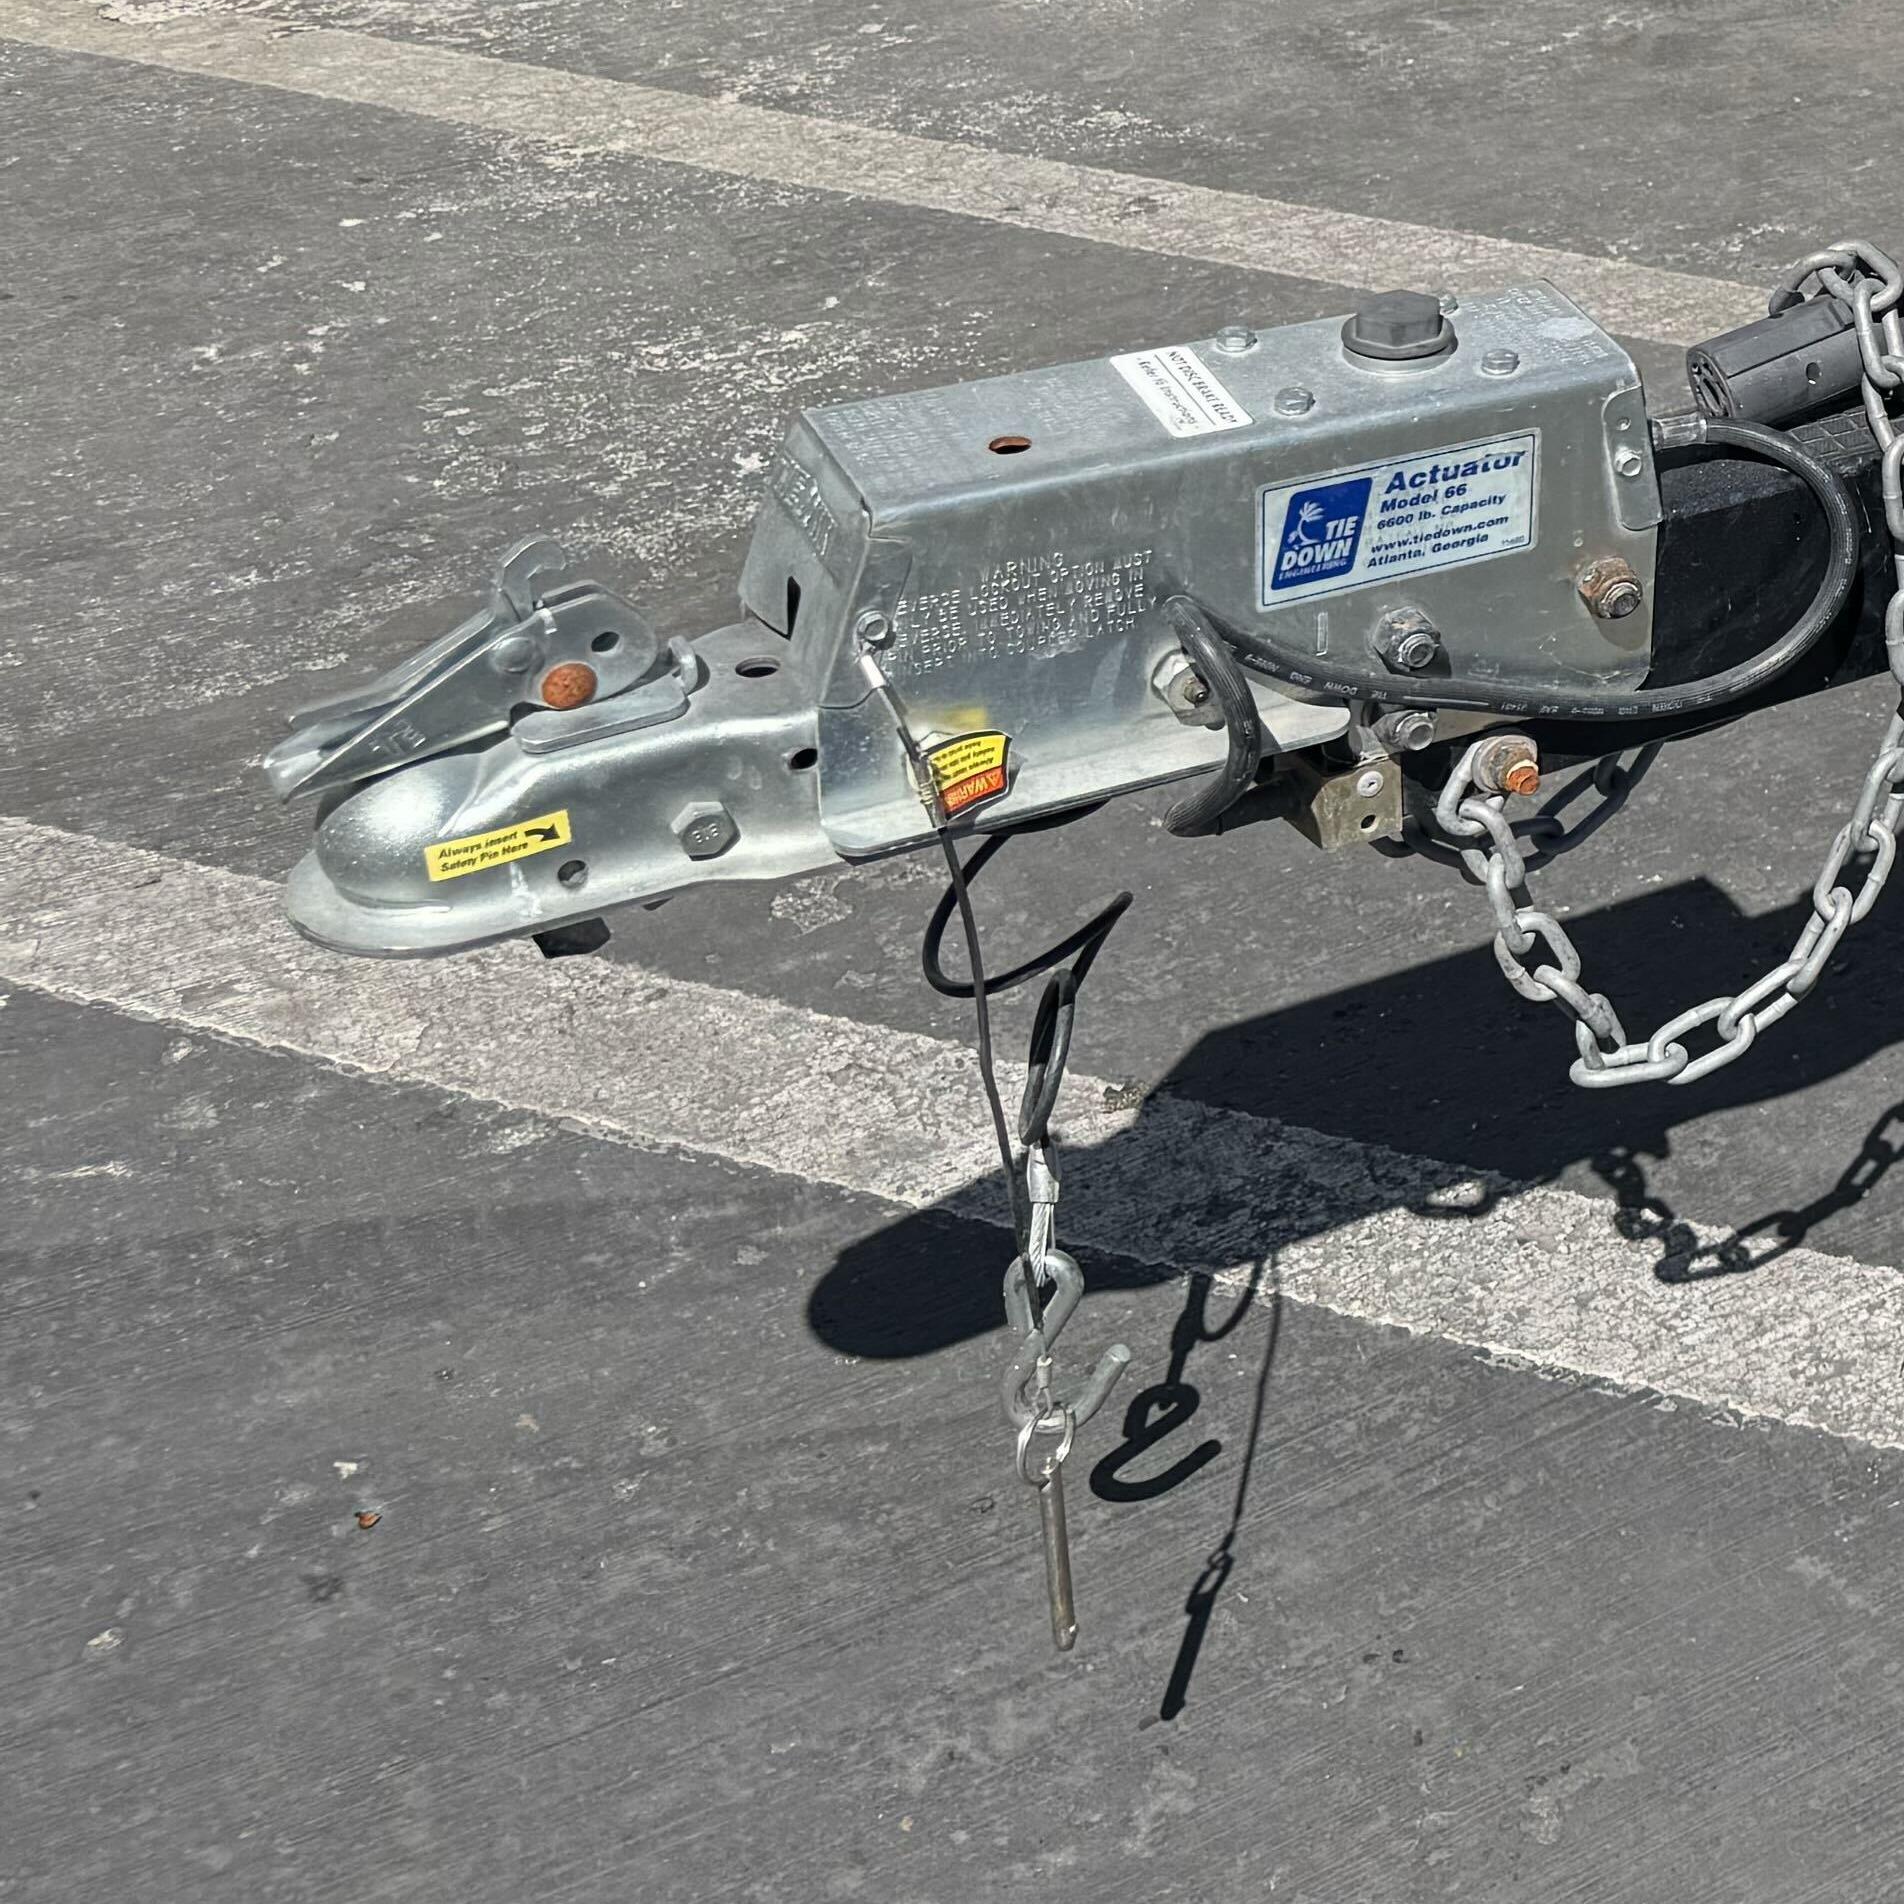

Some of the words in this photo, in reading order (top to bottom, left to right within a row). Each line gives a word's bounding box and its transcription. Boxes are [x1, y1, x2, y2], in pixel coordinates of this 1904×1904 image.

[1385, 450, 1526, 495] Actuator
[1377, 512, 1414, 530] 6600
[1418, 507, 1436, 522] lb.
[1441, 493, 1508, 517] Capacity
[1380, 486, 1439, 514] Model
[1444, 482, 1468, 500] 66
[1325, 515, 1359, 541] TIE
[1371, 515, 1510, 554] www.tiedown.com
[1280, 539, 1352, 571] DOWN
[1367, 546, 1426, 569] Atlanta,
[1431, 532, 1490, 555] Georgia
[438, 842, 482, 861] Always
[485, 830, 518, 850] insert
[440, 855, 478, 873] Safety
[480, 850, 500, 863] Pin
[502, 840, 529, 856] Here
